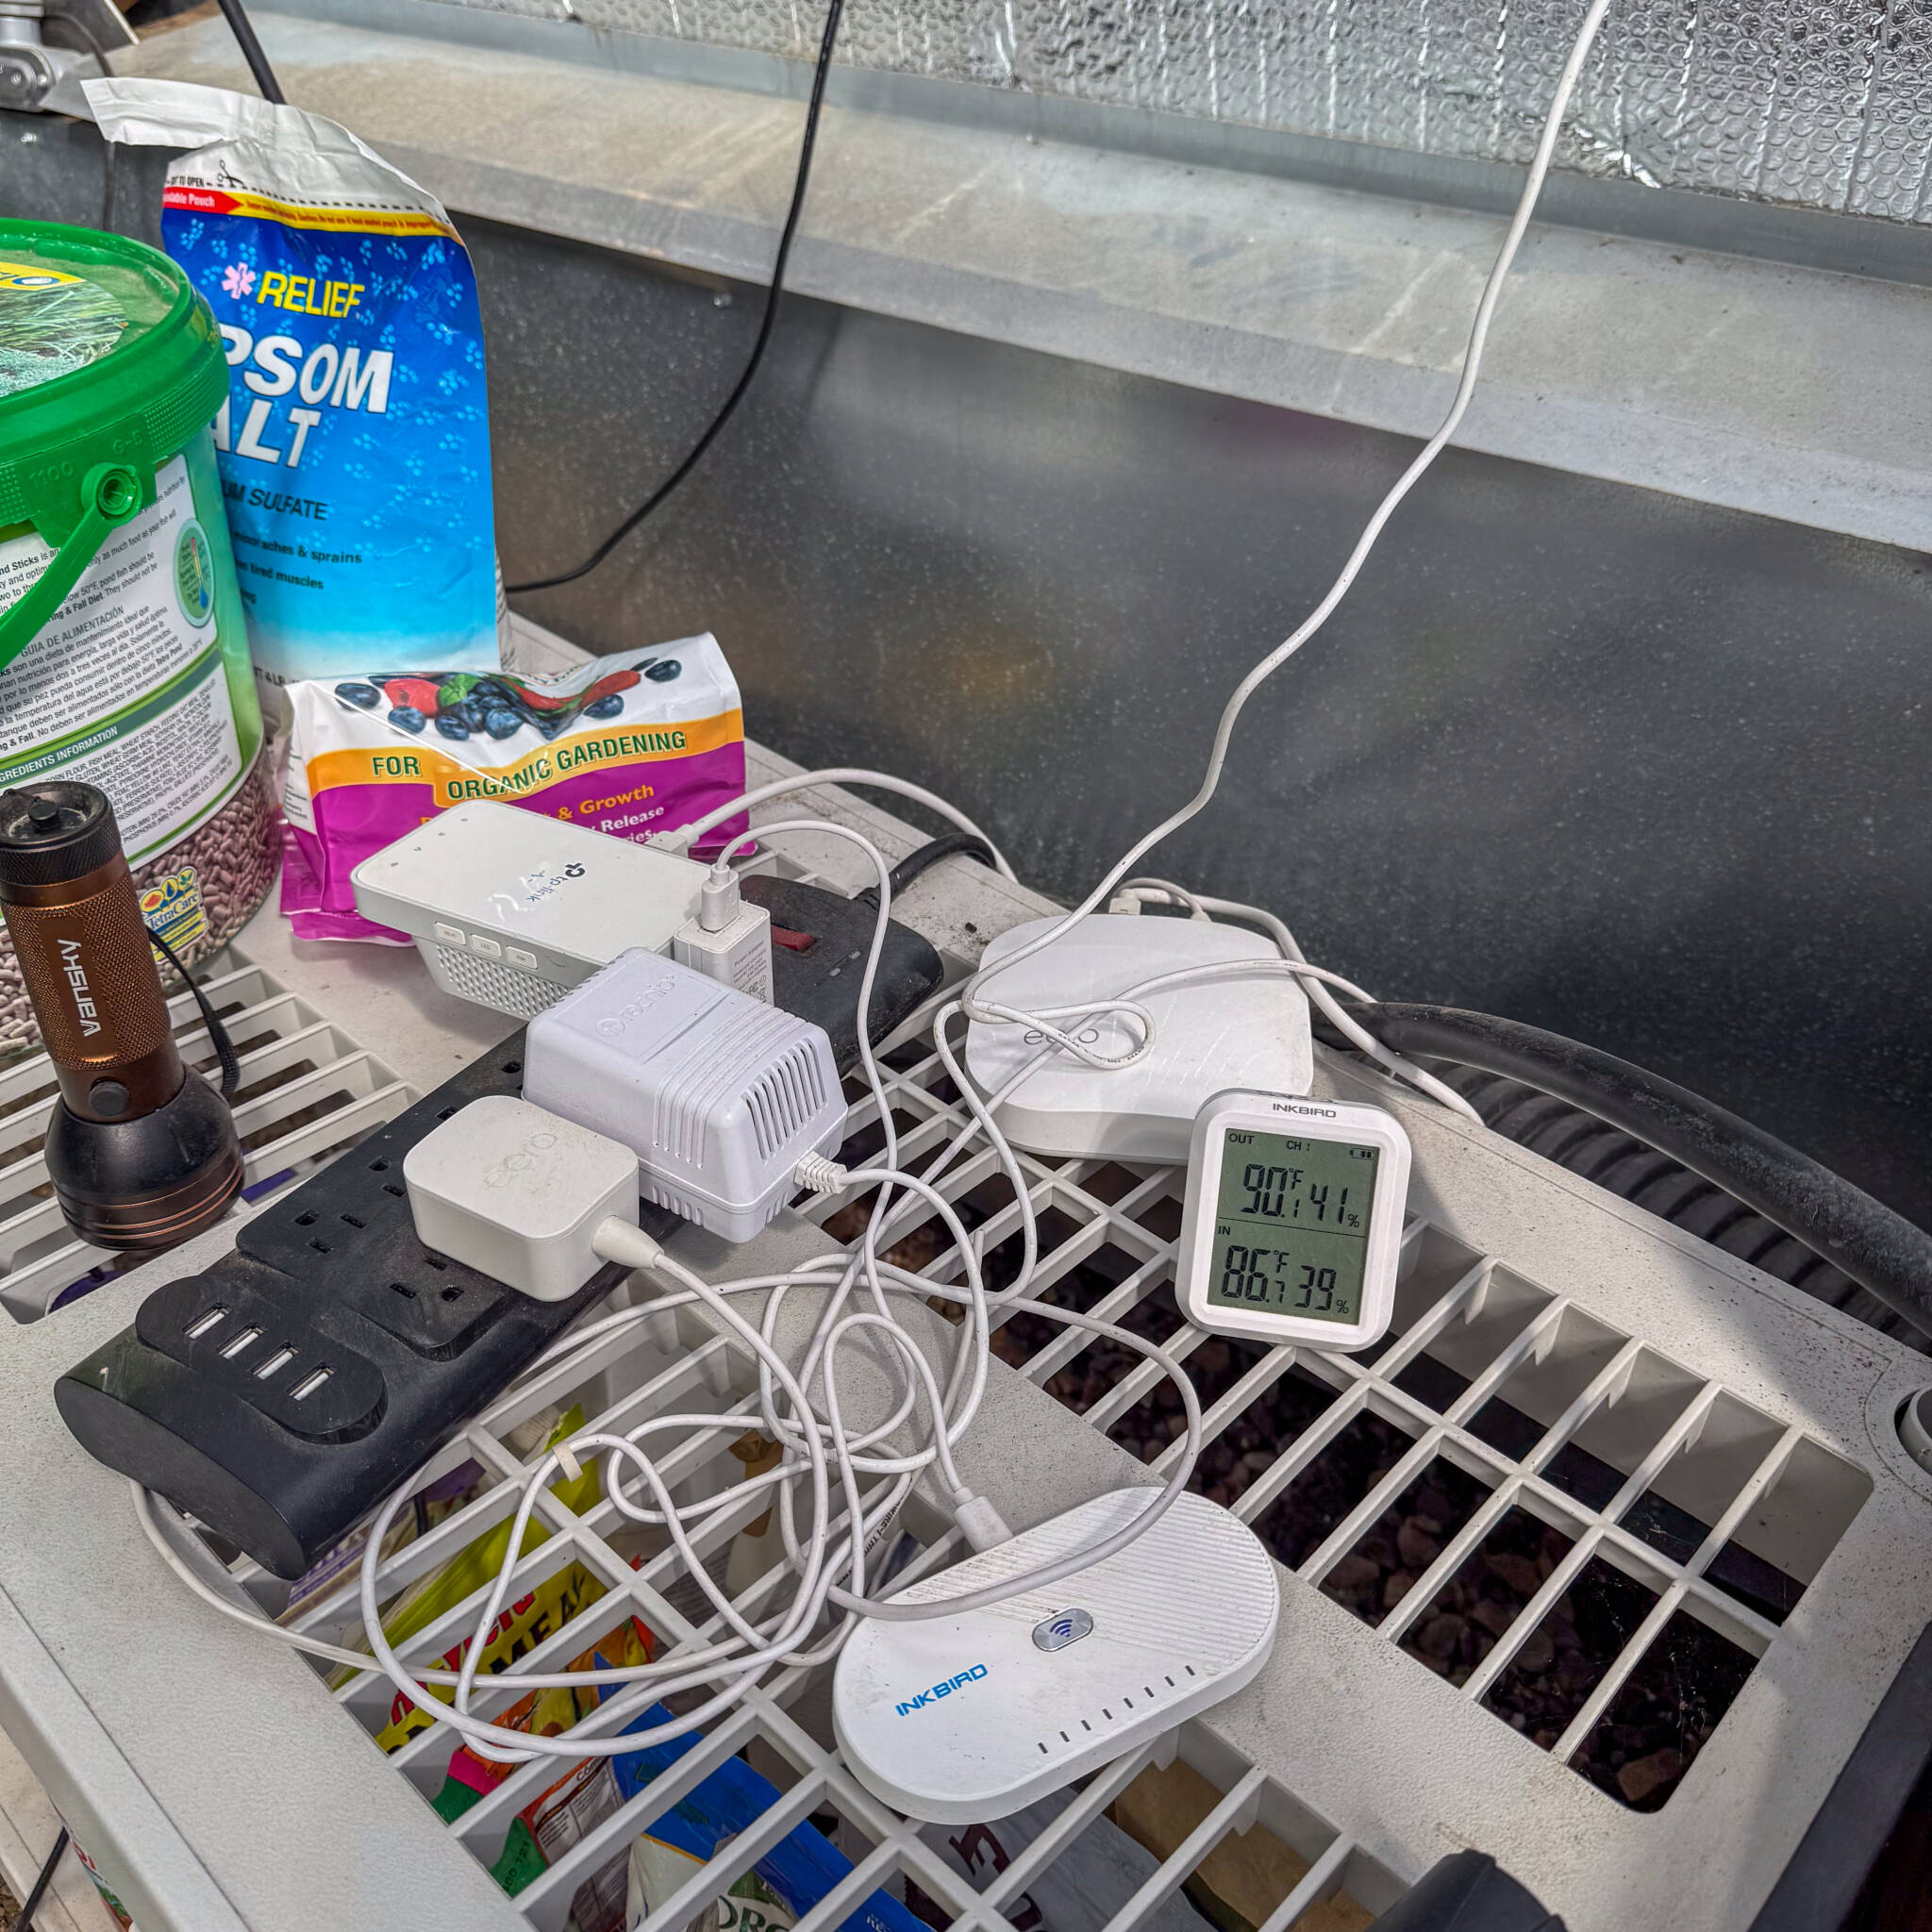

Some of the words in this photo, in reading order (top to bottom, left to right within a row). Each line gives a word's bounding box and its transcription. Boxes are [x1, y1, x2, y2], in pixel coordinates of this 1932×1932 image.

[187, 176, 205, 188] OPEN
[189, 192, 216, 208] Pouch
[257, 270, 365, 319] RELIEF
[219, 323, 394, 415] PSOM
[213, 395, 323, 469] ALT
[222, 480, 247, 503] UM
[248, 489, 328, 521] SULFATE
[0, 563, 10, 575] nd
[11, 556, 40, 572] Sticks
[41, 552, 48, 561] is
[49, 547, 59, 558] an
[102, 550, 111, 561] as
[111, 541, 129, 557] much
[128, 533, 142, 546] food
[261, 540, 295, 557] aches
[297, 544, 308, 558] &
[311, 550, 363, 565] sprains
[0, 591, 11, 602] wo
[12, 586, 22, 596] to
[8, 574, 25, 586] and
[25, 564, 50, 580] optim
[65, 606, 73, 616] &
[74, 598, 88, 613] Fall
[104, 584, 122, 598] They
[121, 572, 142, 589] should
[99, 574, 116, 590] pond
[250, 562, 274, 580] tired
[275, 570, 325, 590] muscles
[12, 662, 28, 674] son
[28, 656, 45, 667] una
[45, 647, 65, 661] dieta
[65, 643, 75, 654] de
[75, 619, 125, 649] mantenimiento
[21, 641, 45, 658] GUIA
[45, 635, 61, 649] DE
[61, 605, 125, 642] ALIMENTACIÓN
[4, 690, 18, 703] por
[19, 686, 28, 696] lo
[28, 678, 55, 692] menos
[56, 672, 70, 681] dos
[76, 662, 92, 674] tres
[92, 652, 111, 666] veces
[17, 664, 53, 683] nutrición
[53, 658, 71, 672] para
[98, 637, 116, 650] larga
[6, 715, 14, 724] la
[14, 697, 63, 722] temperatura
[63, 691, 75, 703] del
[75, 684, 94, 698] agua
[93, 677, 109, 690] está
[7, 701, 23, 714] que
[23, 696, 34, 706] su
[34, 691, 50, 704] pez
[50, 681, 74, 698] pueda
[74, 666, 106, 686] consumir
[0, 723, 28, 738] tanque
[29, 714, 54, 728] deben
[54, 708, 67, 719] ser
[67, 689, 110, 713] alimentados
[0, 742, 8, 752] ng
[9, 738, 17, 747] &
[37, 727, 49, 738] No
[50, 716, 74, 730] deben
[75, 711, 87, 724] ser
[87, 692, 126, 717] alimentados
[0, 754, 56, 784] GREDIENTS
[56, 725, 119, 762] INFORMATION
[372, 755, 423, 778] FOR
[446, 756, 553, 800] ORGANIC
[555, 730, 688, 772] GARDENING
[558, 806, 574, 820] &
[578, 784, 656, 816] Growth
[599, 805, 665, 833] Release
[525, 875, 569, 902] tp-link
[1272, 1102, 1338, 1119] INKBIRD
[1228, 1132, 1256, 1146] OUT
[1286, 1139, 1303, 1152] CH
[1217, 1225, 1232, 1237] IN
[894, 1662, 989, 1717] INKBIRD
